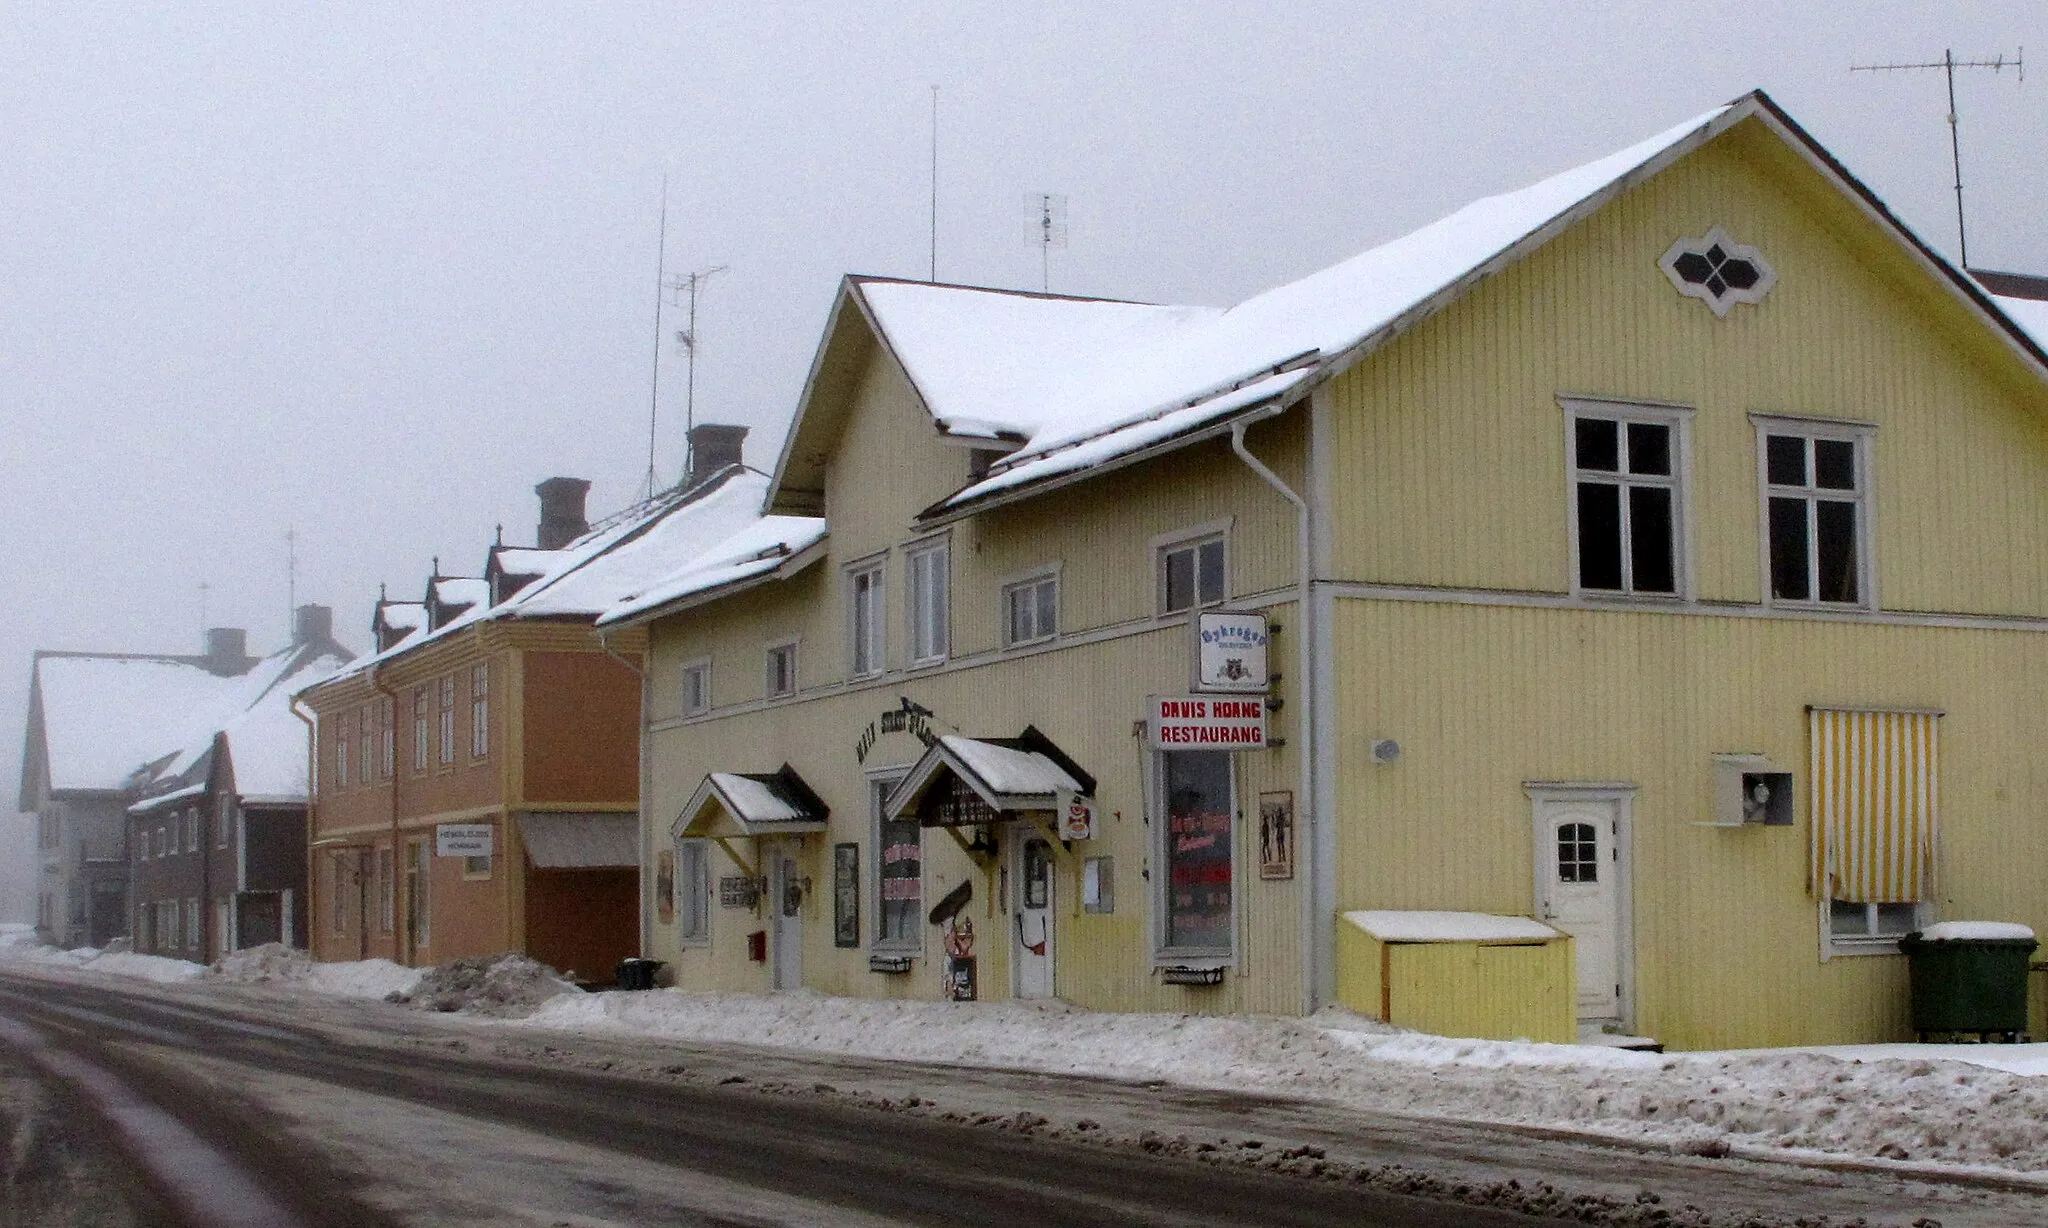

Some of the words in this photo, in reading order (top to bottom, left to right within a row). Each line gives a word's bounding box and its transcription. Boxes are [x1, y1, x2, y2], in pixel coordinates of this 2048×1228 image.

[1160, 701, 1206, 719] DAVIS
[1213, 701, 1261, 719] HOANG
[1160, 726, 1262, 743] RESTAURANG
